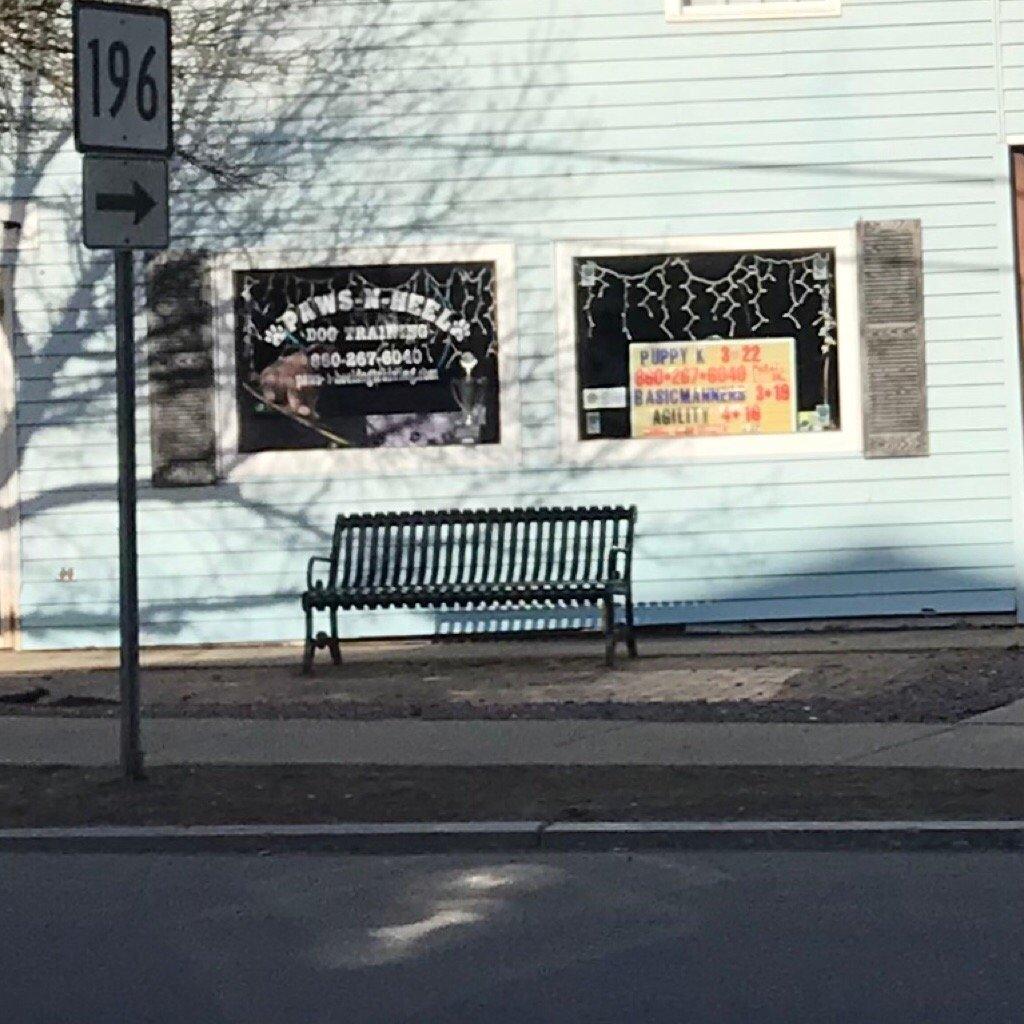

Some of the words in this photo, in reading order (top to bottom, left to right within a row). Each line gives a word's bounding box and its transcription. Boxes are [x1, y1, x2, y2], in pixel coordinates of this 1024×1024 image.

[87, 38, 157, 121] 196
[306, 327, 338, 342] DOG
[345, 324, 428, 341] TRAINING
[640, 347, 687, 365] PUPPY
[653, 407, 709, 426] AGILITY
